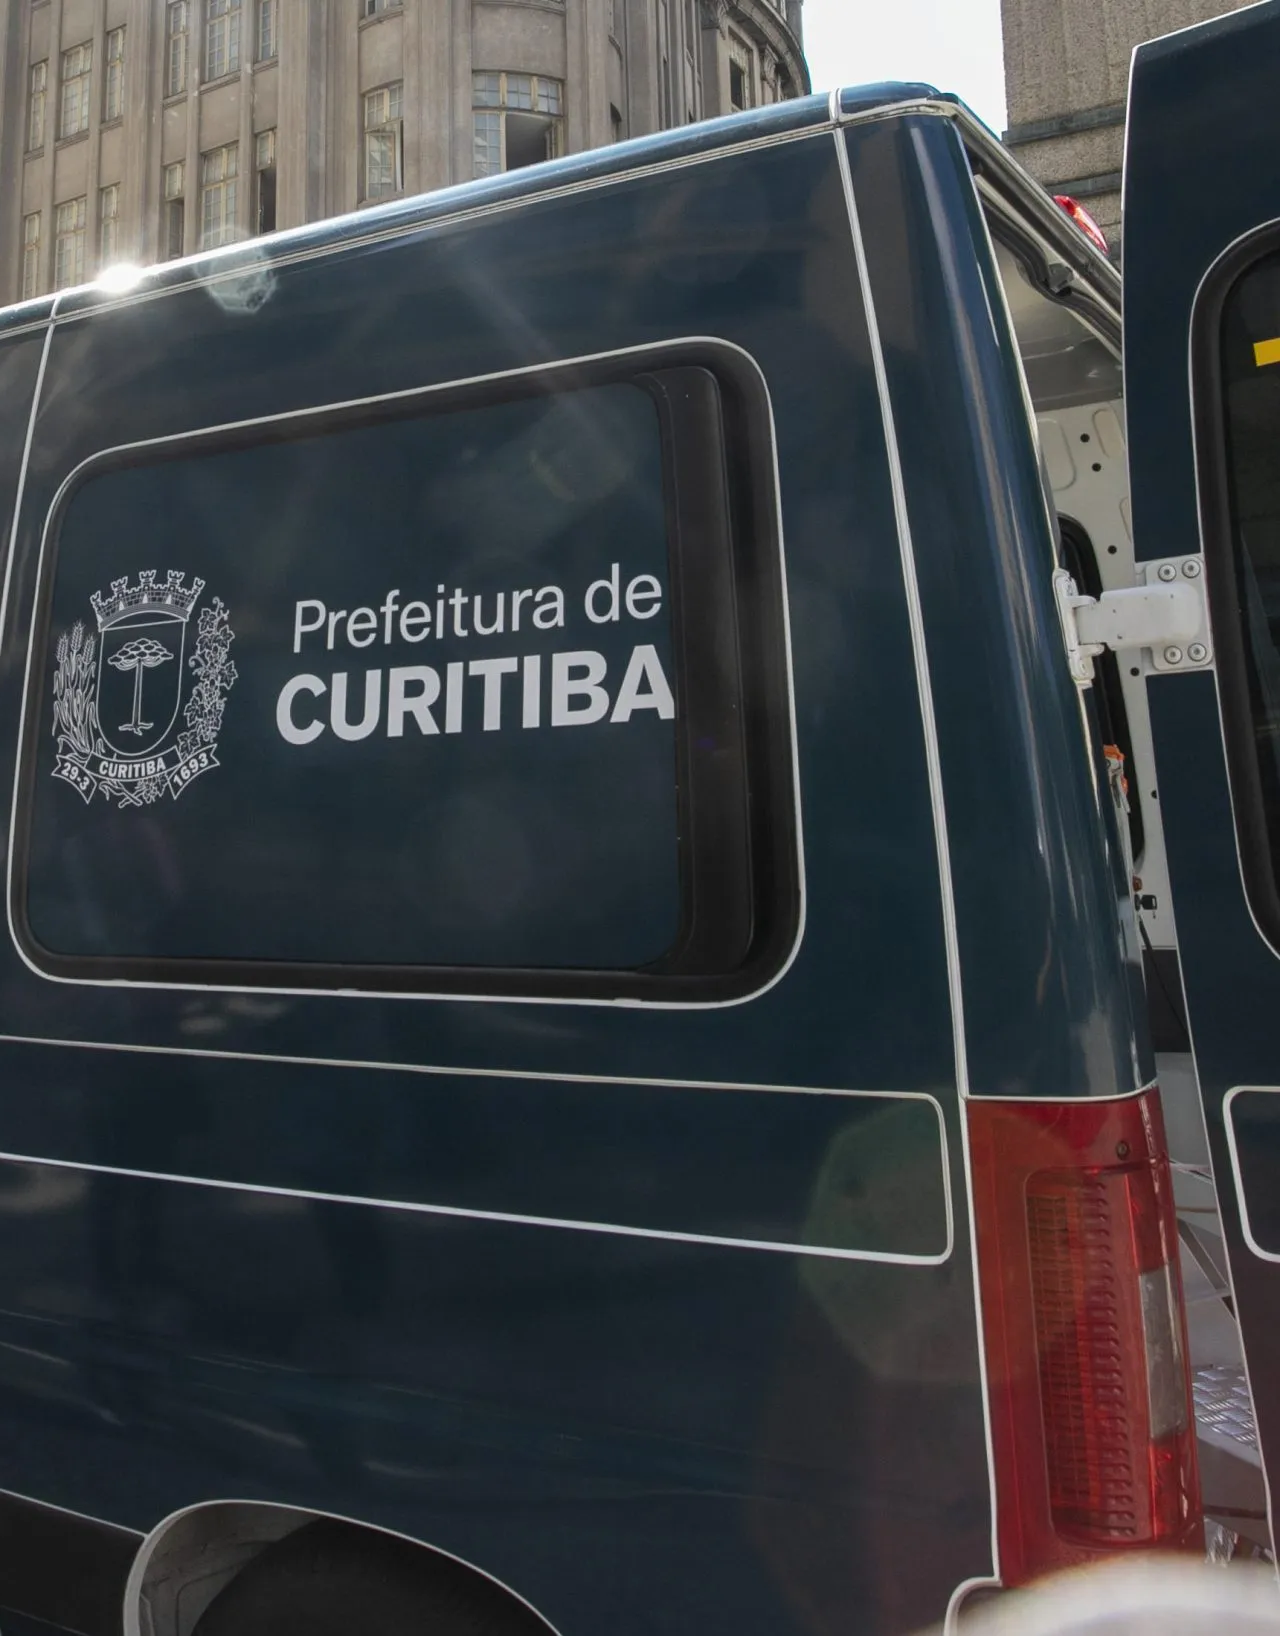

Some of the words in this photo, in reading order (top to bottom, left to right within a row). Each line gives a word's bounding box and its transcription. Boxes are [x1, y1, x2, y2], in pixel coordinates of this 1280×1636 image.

[293, 584, 565, 654] Prefeitura
[584, 562, 662, 624] de
[276, 644, 675, 746] CURITIBA
[60, 761, 91, 792] 29-3
[98, 757, 167, 780] CURITIBA
[172, 752, 209, 788] 1693
